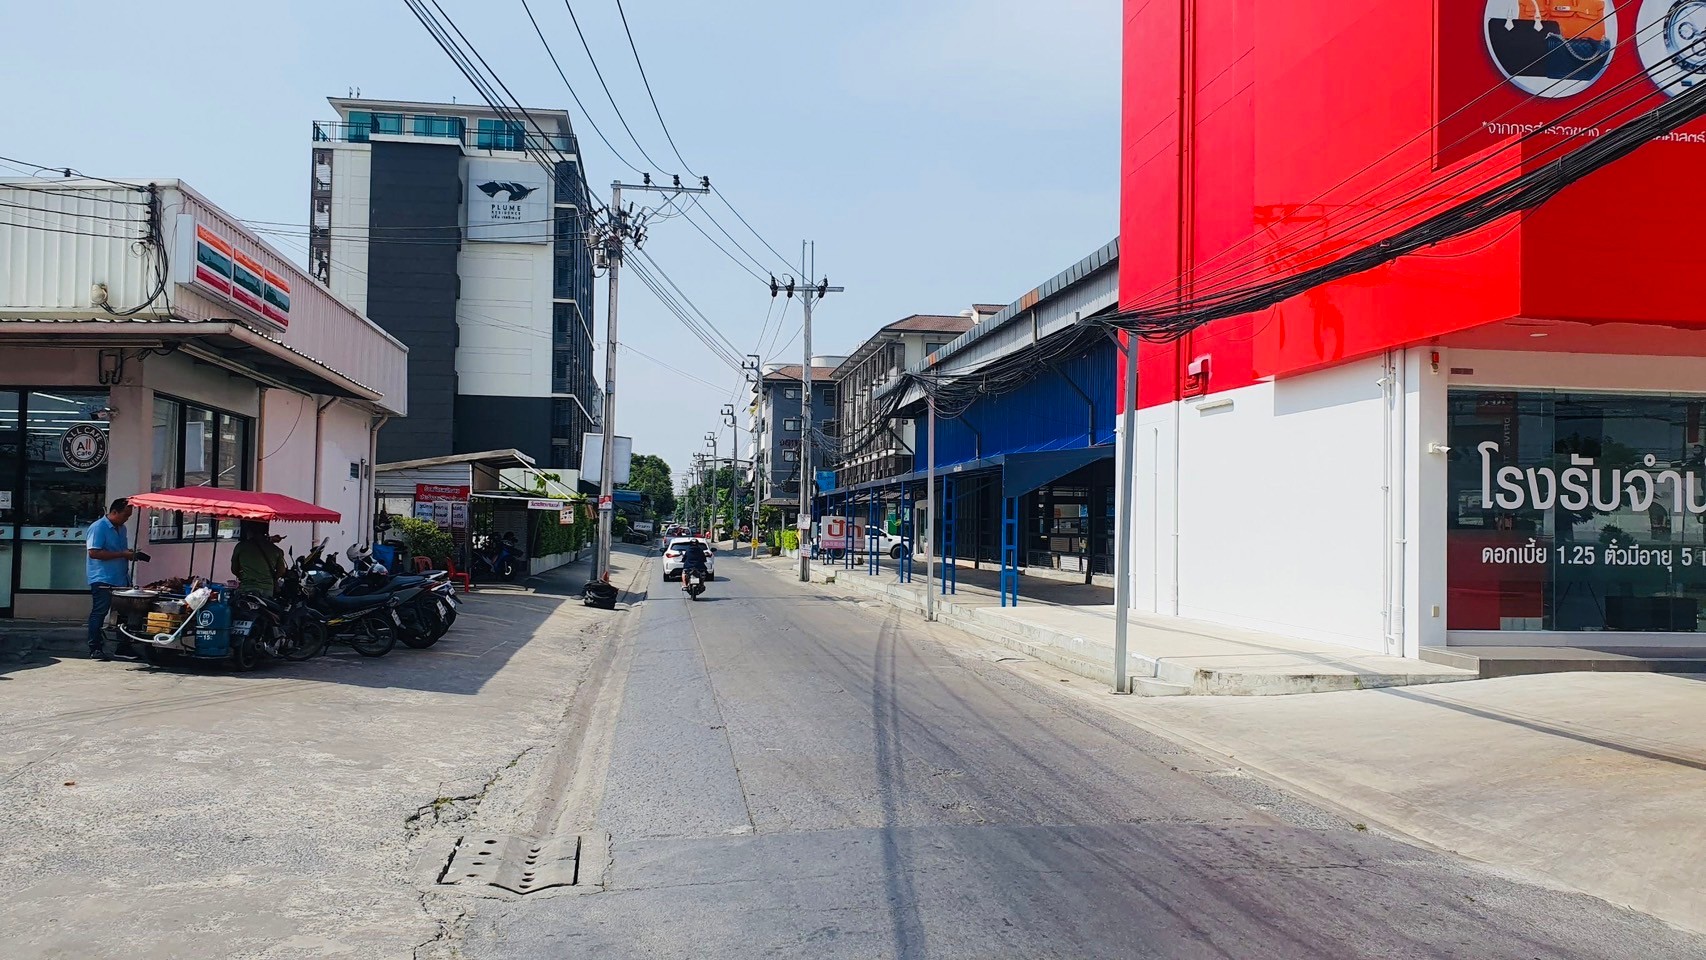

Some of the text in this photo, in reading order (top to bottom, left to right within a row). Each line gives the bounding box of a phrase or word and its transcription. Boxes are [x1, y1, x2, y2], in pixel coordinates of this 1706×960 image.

[66, 426, 103, 444] ALL CAFE
[77, 438, 92, 450] All
[1477, 440, 1706, 513] โรงรับจำน
[1481, 537, 1547, 564] ดอกเบี้ย
[1556, 545, 1596, 566] 1.25
[1604, 538, 1673, 573] ตั๋วมีอายุ
[1681, 547, 1692, 567] 5
